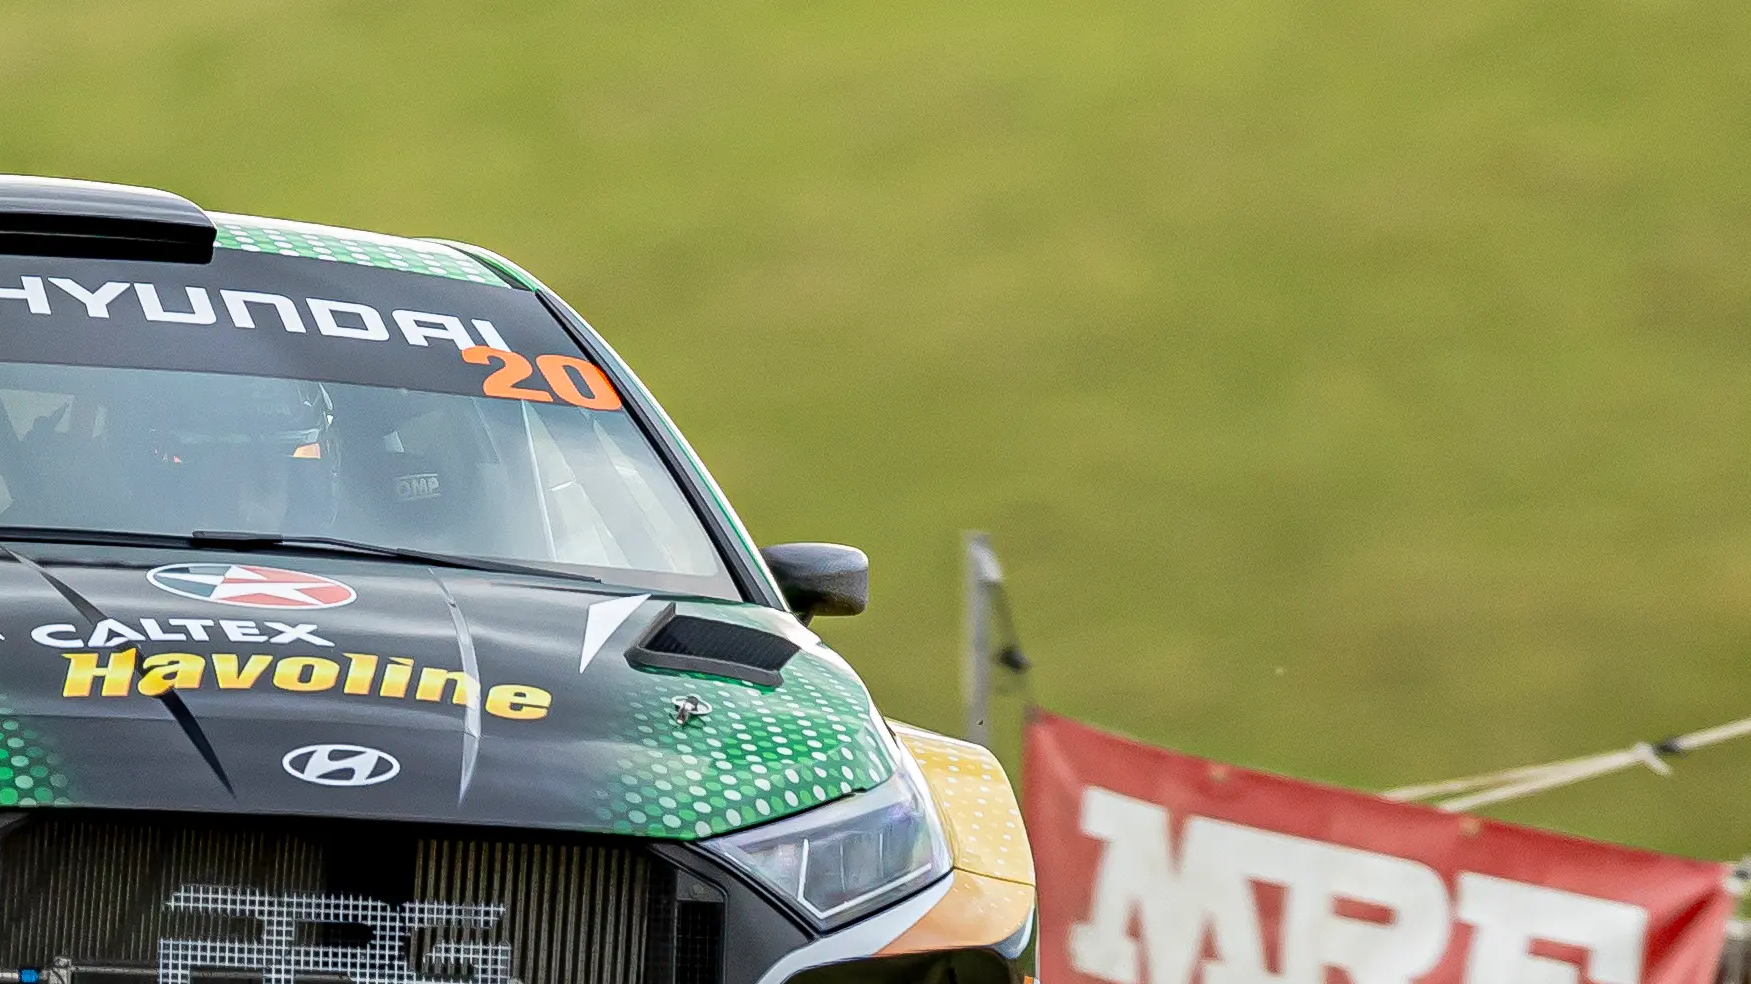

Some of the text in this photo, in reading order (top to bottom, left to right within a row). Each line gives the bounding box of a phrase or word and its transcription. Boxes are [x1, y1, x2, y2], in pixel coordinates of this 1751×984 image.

[461, 345, 623, 411] 20
[29, 617, 335, 649] CALTEX
[61, 647, 552, 720] Havoline
